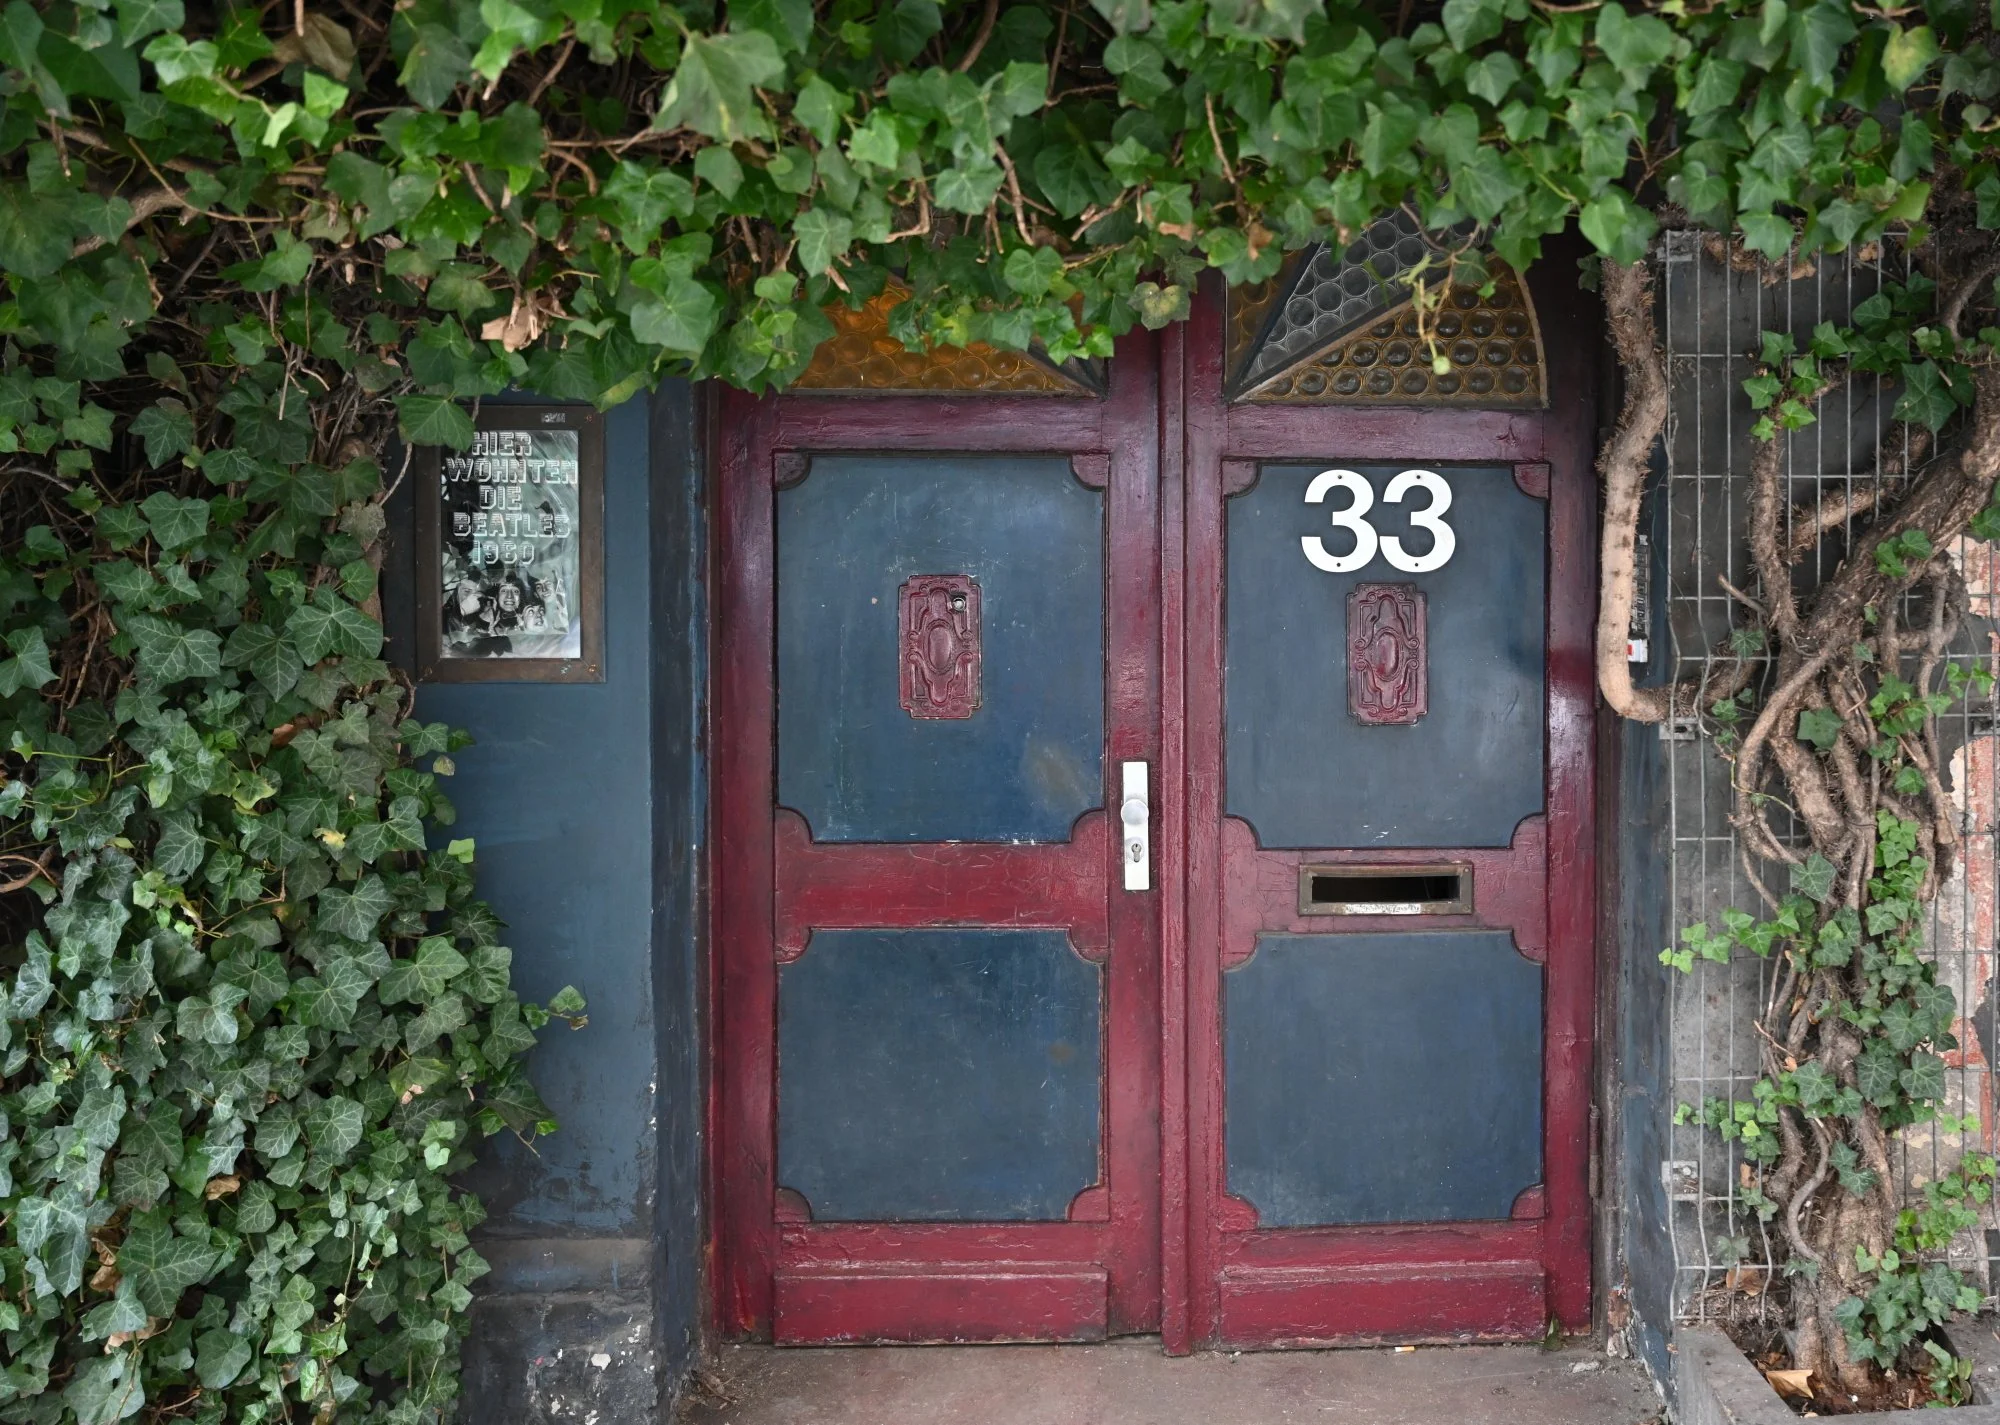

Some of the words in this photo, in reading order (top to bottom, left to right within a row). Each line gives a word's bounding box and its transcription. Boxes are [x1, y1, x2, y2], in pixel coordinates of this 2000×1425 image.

[472, 431, 532, 456] HIER
[446, 458, 578, 484] WOHNTEN
[479, 485, 522, 510] DIE
[453, 512, 571, 538] BEATLES
[1301, 469, 1456, 573] 33
[472, 540, 535, 565] 1960
